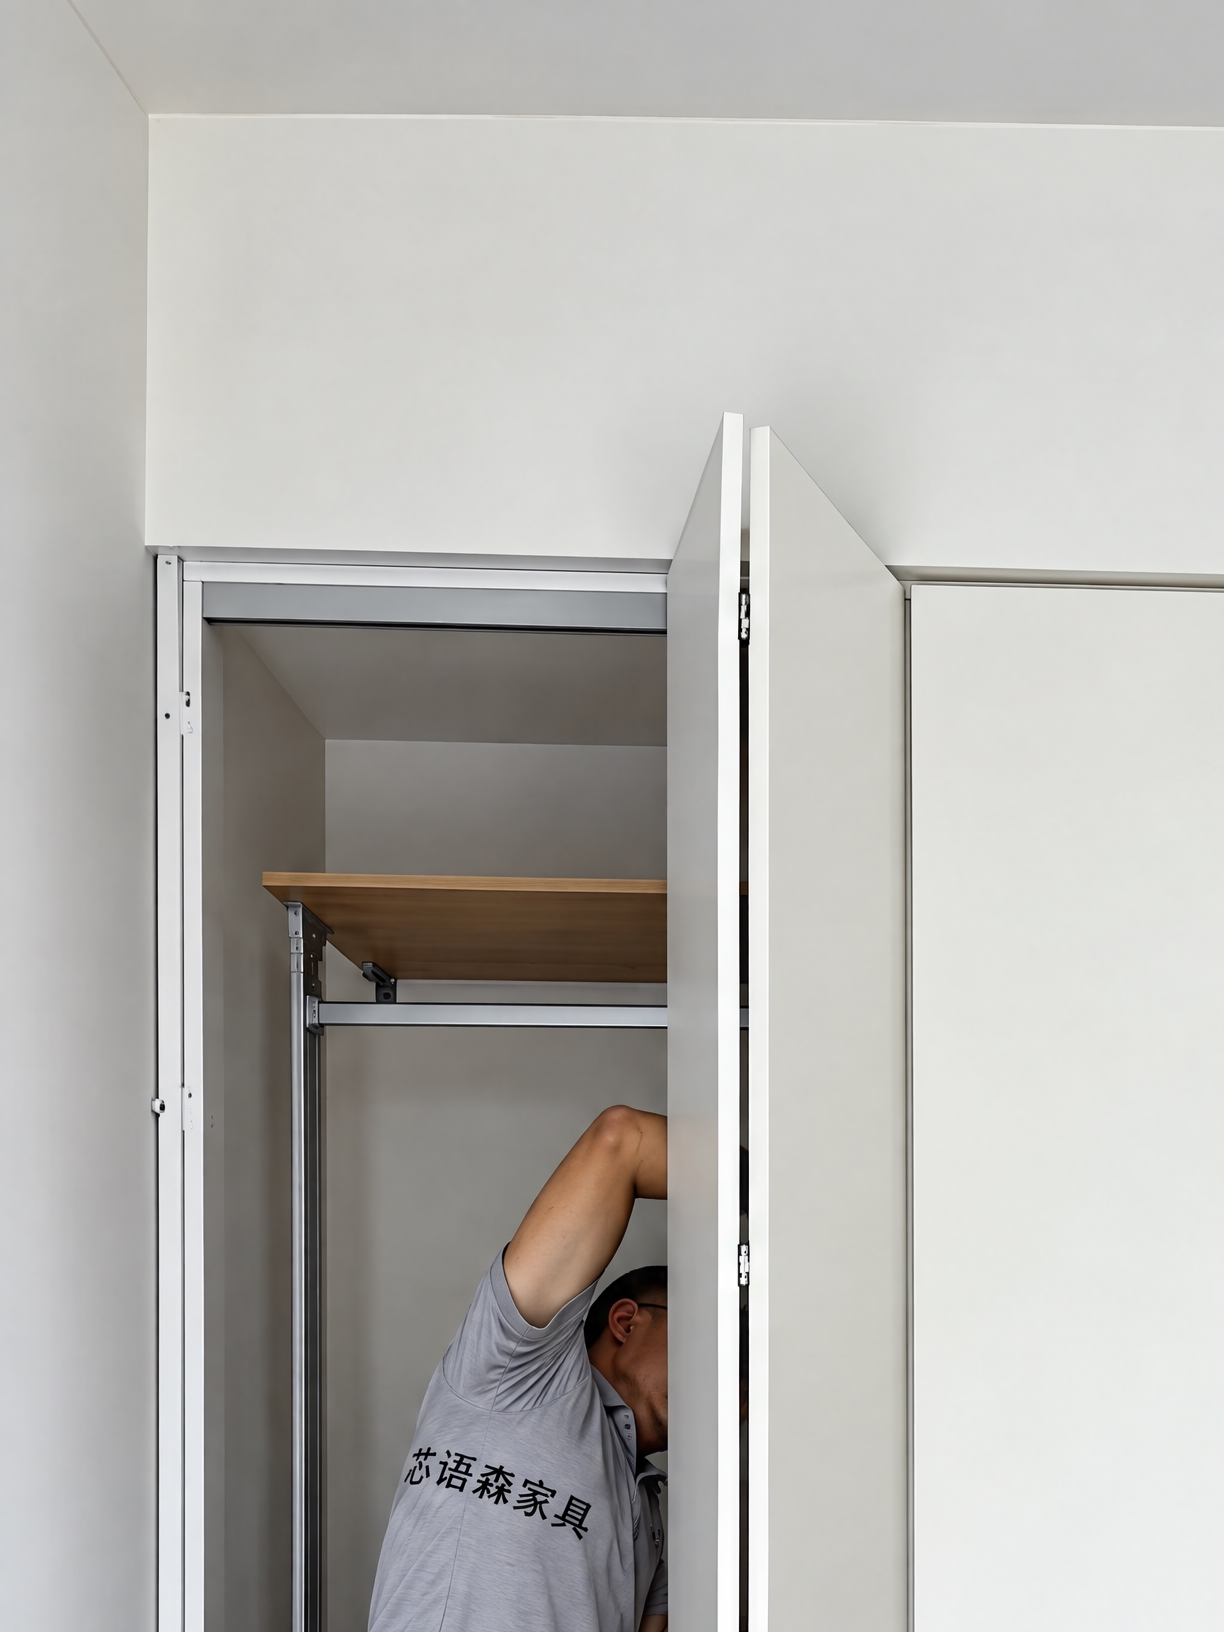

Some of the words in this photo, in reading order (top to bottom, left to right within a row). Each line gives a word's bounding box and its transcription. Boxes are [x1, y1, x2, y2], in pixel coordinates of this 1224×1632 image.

[404, 1447, 592, 1540] 芯语森家具
